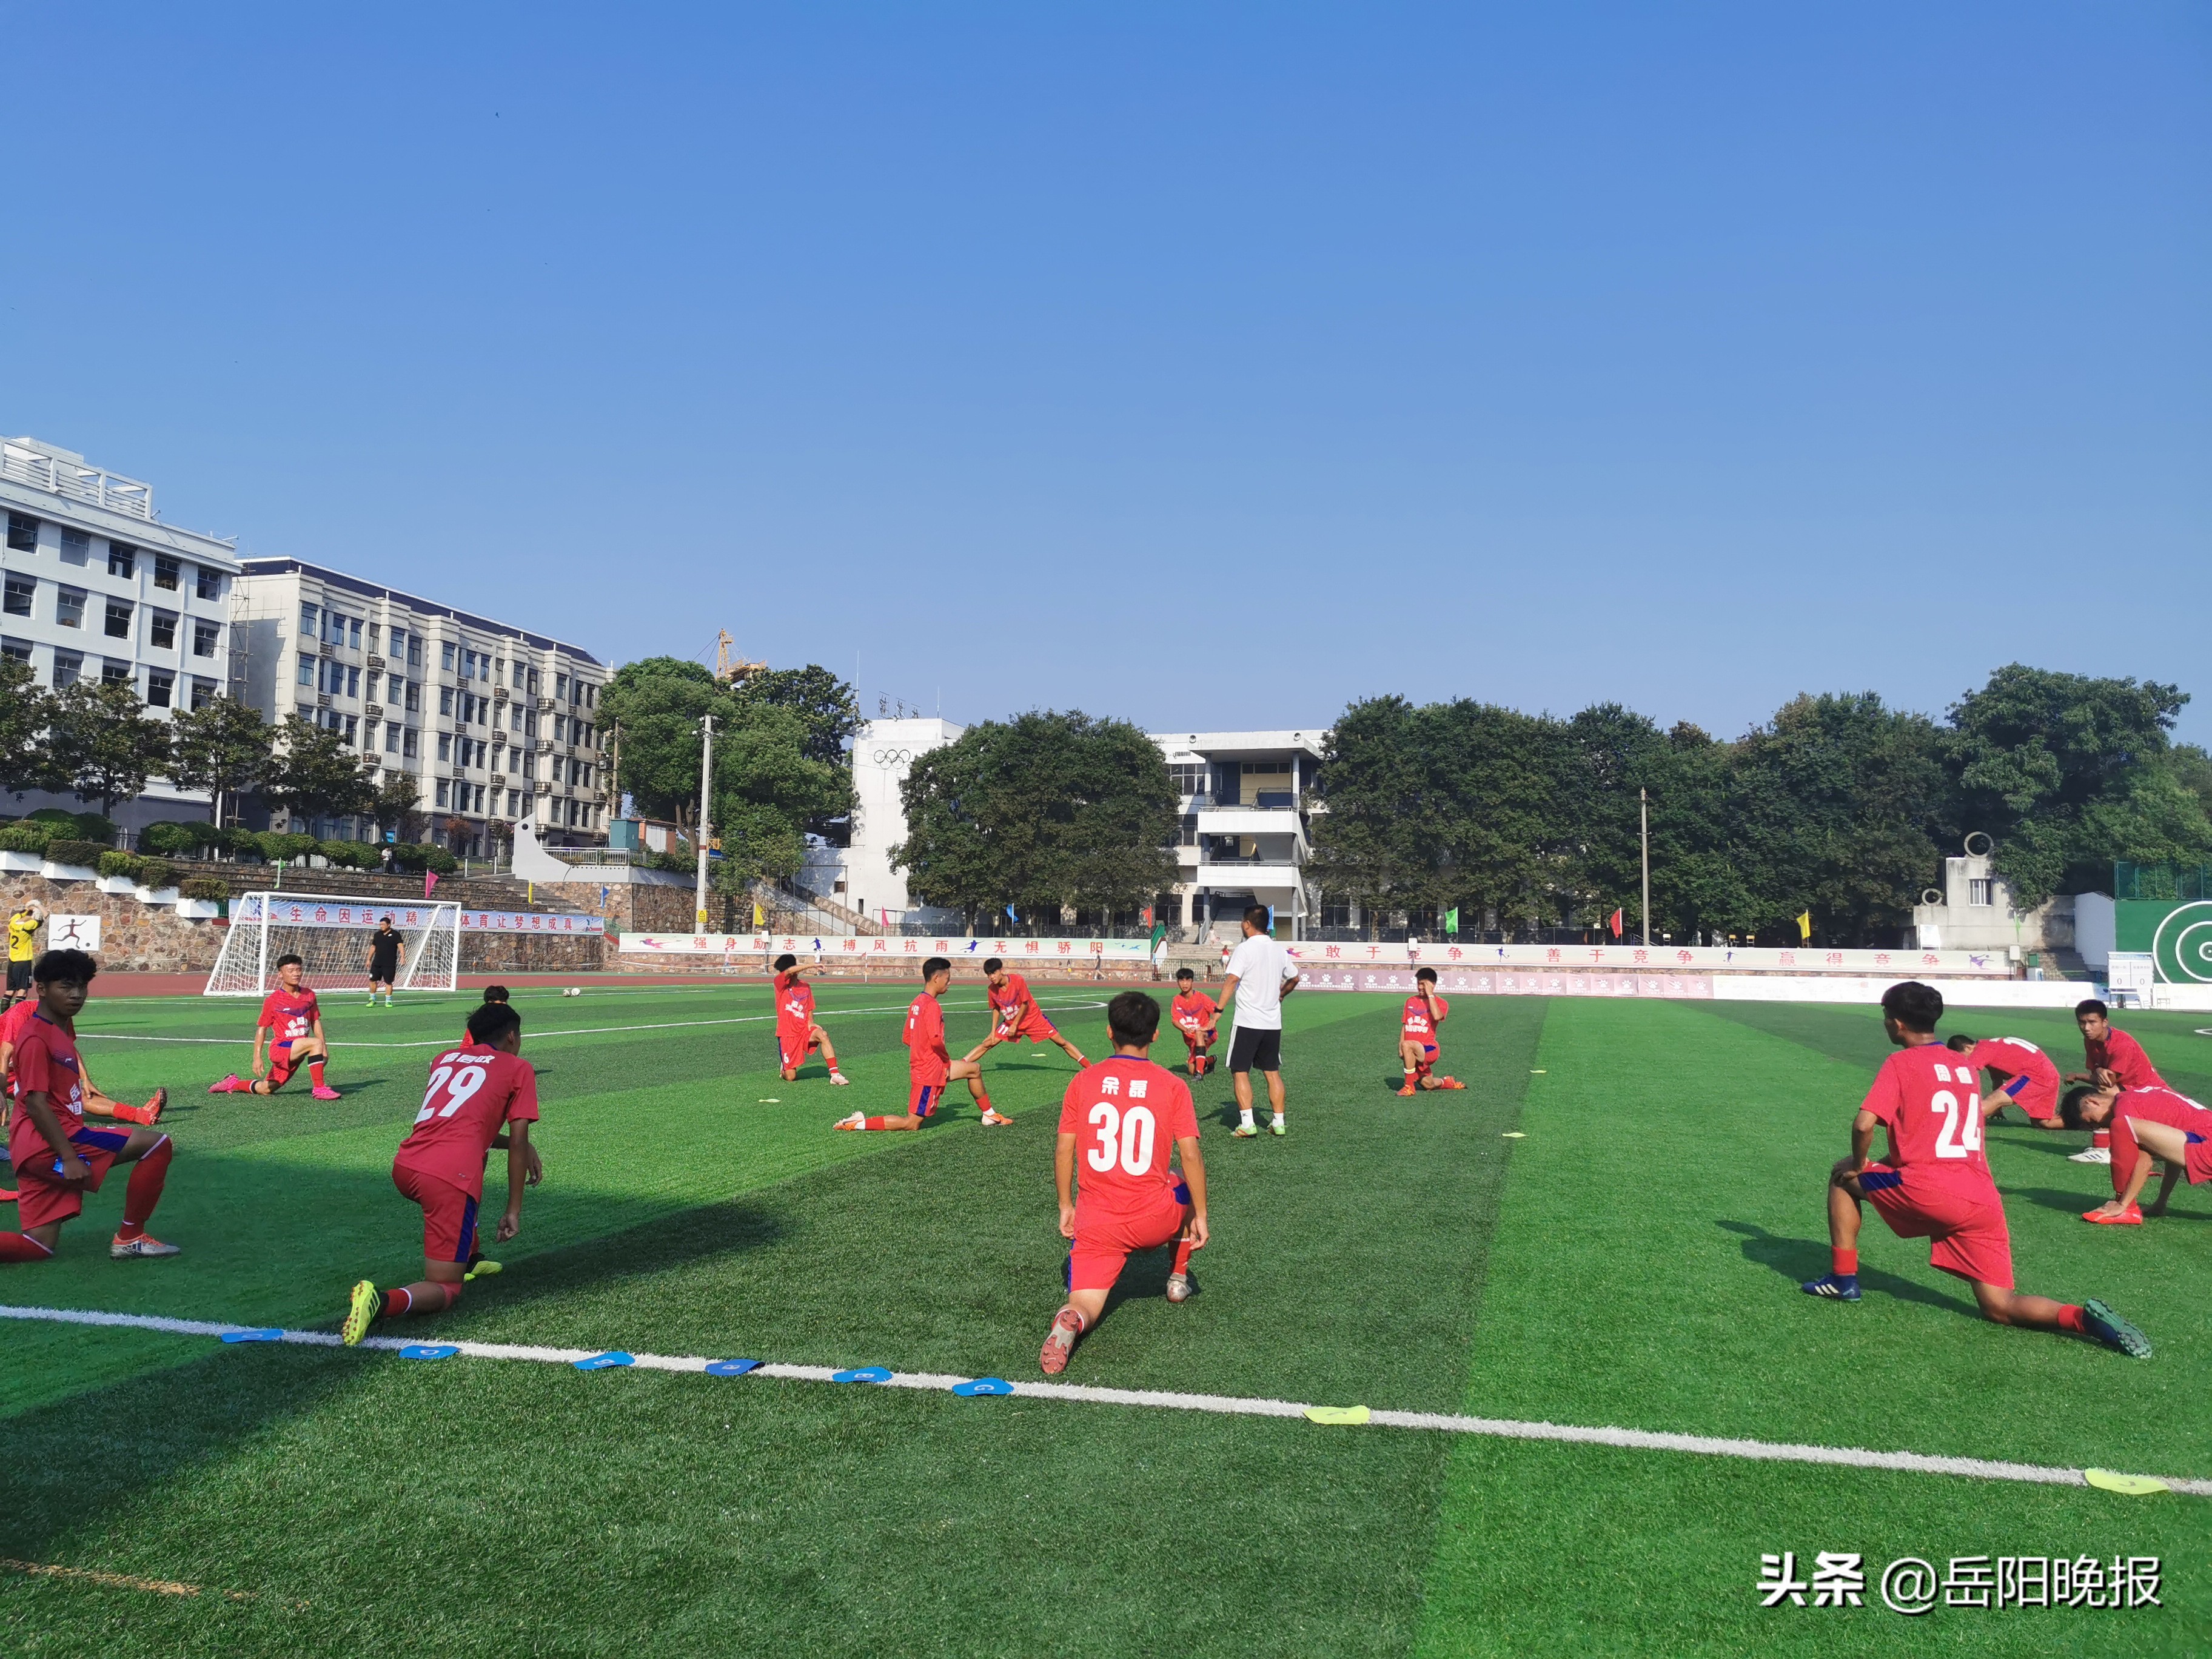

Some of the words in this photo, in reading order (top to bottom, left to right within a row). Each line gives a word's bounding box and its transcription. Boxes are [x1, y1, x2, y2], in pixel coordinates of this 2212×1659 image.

[460, 912, 572, 931] 体育让梦想成真
[694, 937, 796, 950] 强身励志
[843, 939, 948, 953] 搏风抗雨
[994, 940, 1103, 954] 无惧骄阳
[1546, 948, 1694, 964] 善于竞争
[1778, 951, 1940, 968] 赢得竞争
[784, 1053, 789, 1064] 6
[414, 1066, 486, 1124] 29
[1101, 1076, 1148, 1098] 余磊
[1931, 1090, 1982, 1159] 24
[1088, 1102, 1155, 1176] 30
